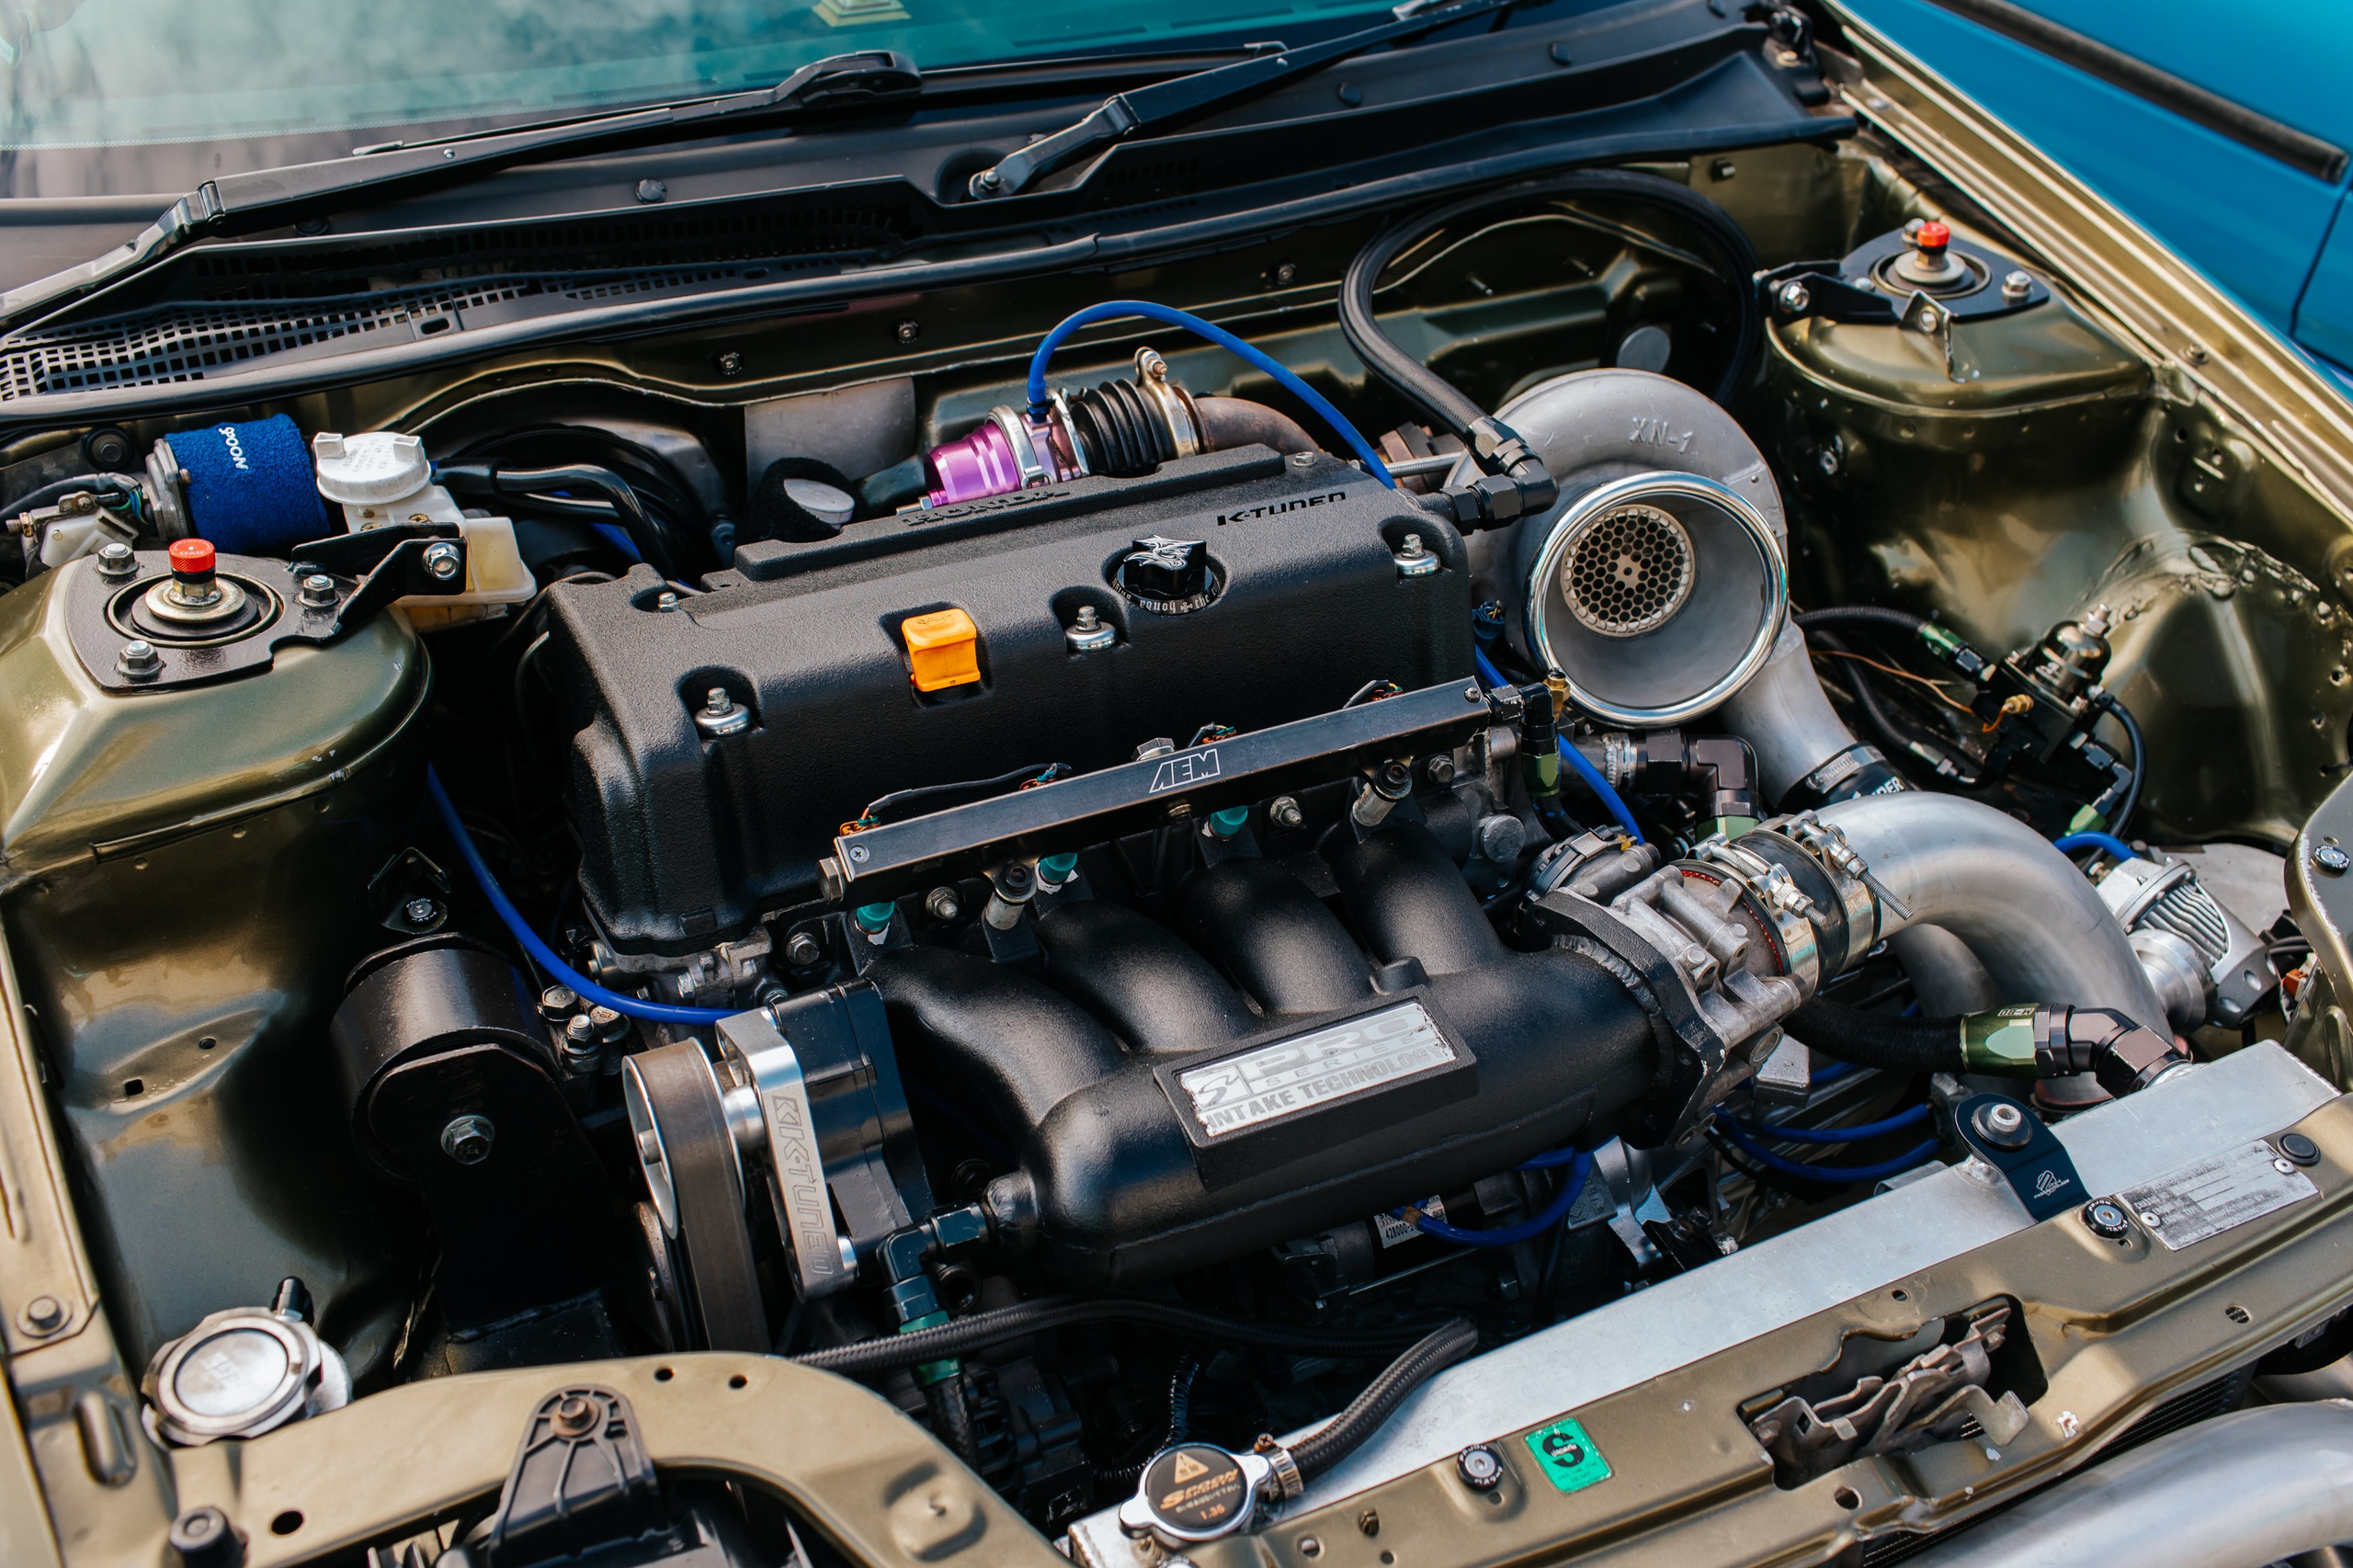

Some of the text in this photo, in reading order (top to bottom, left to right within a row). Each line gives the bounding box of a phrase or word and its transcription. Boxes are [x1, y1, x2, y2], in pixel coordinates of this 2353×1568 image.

[1629, 416, 1693, 455] XN-1
[1217, 491, 1347, 526] K-TUNED
[1149, 748, 1221, 793] AEM
[1240, 1012, 1426, 1080] PRO
[1266, 1035, 1415, 1086] SERIES
[1206, 1044, 1445, 1130] INTAKE TECHNOLOGY
